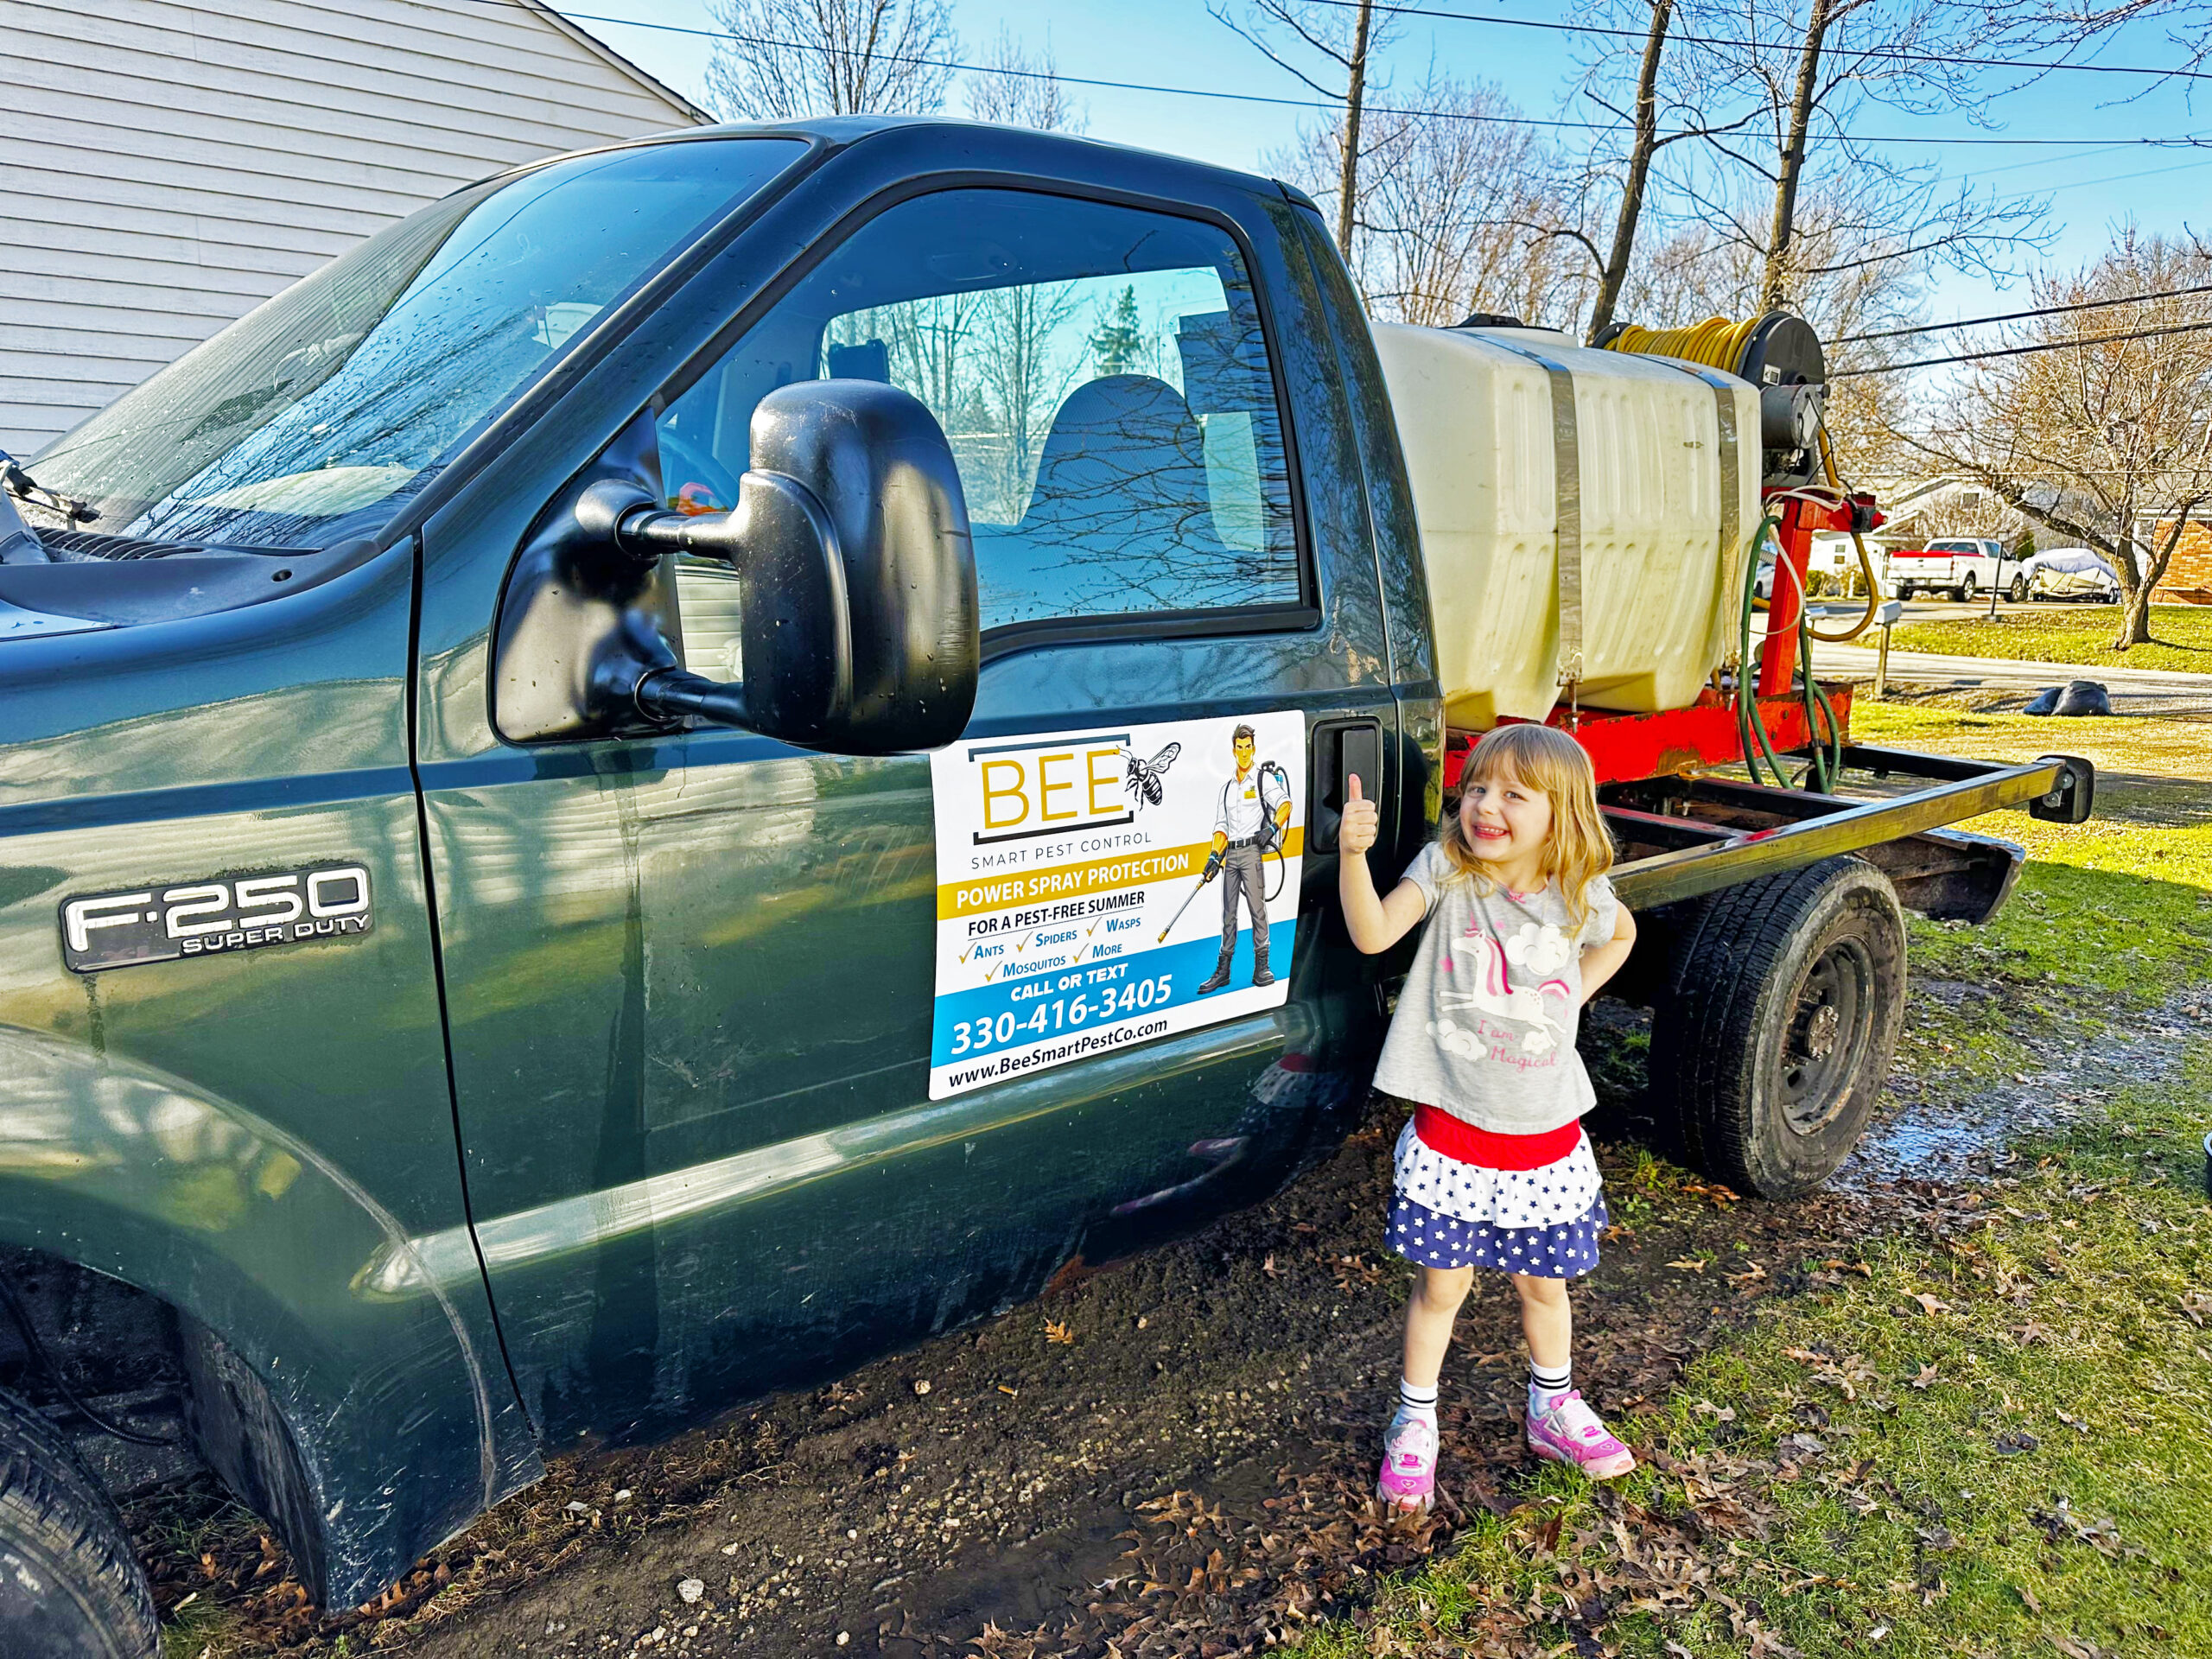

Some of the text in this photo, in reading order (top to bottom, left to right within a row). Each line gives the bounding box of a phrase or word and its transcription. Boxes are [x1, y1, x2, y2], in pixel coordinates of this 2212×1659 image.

[982, 748, 1124, 830] BEE
[971, 831, 1152, 869] SMART PEST CONTROL
[957, 853, 1189, 908] POWER SPRAY PROTECTION
[181, 914, 370, 954] SUPER DUTY
[969, 891, 1145, 936] FOR A PEST-FREE SUMMER
[1010, 963, 1128, 1001] CALL OR TEXT
[950, 975, 1173, 1054] 330-416-3405
[1477, 1020, 1514, 1042] I am
[949, 1020, 1168, 1087] www.BeeSmartPestCo.com
[1490, 1045, 1557, 1074] Magical
